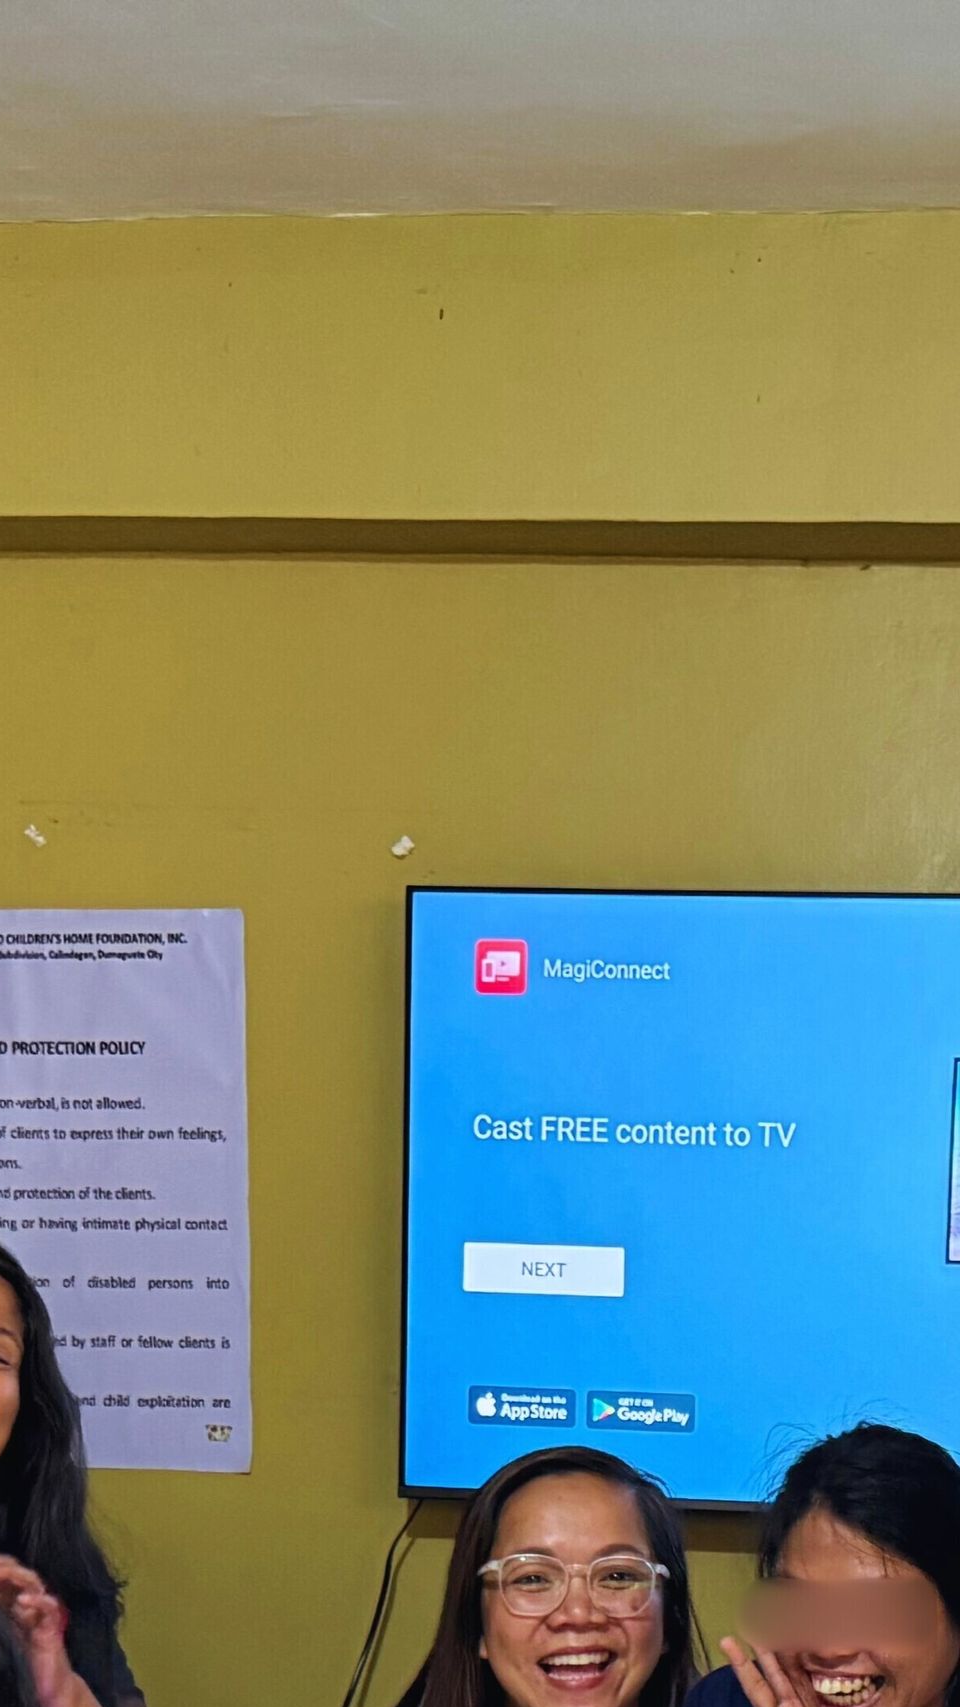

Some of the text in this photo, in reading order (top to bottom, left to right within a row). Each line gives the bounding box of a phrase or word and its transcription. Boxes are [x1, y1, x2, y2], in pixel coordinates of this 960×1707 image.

[6, 933, 62, 945] CHILDREN'S
[63, 933, 94, 944] HOME
[96, 932, 166, 946] FOUNDATION,
[167, 932, 188, 944] INC.
[146, 949, 162, 961] City
[543, 958, 671, 984] MagiConnect
[12, 1040, 96, 1055] PROTECTION
[100, 1040, 146, 1055] POLICY
[60, 1097, 70, 1110] is
[73, 1099, 93, 1110] not
[96, 1096, 146, 1110] allowed.
[10, 1126, 50, 1140] clients
[52, 1128, 66, 1140] to
[70, 1130, 114, 1142] express
[116, 1127, 144, 1140] their
[148, 1130, 174, 1140] own
[178, 1126, 227, 1142] feelings,
[472, 1114, 796, 1148] Cast FREE content to TV
[13, 1186, 75, 1201] protection
[78, 1186, 92, 1200] of
[94, 1186, 112, 1200] the
[114, 1186, 156, 1200] clients.
[21, 1218, 36, 1229] or
[39, 1217, 78, 1232] having
[82, 1217, 131, 1231] intimate
[134, 1217, 181, 1232] physical
[184, 1218, 228, 1231] contact
[520, 1260, 567, 1279] NEXT
[62, 1276, 76, 1288] of
[87, 1276, 136, 1289] disabled
[148, 1278, 194, 1291] persons
[206, 1276, 230, 1290] into
[72, 1336, 86, 1350] by
[90, 1336, 116, 1348] staff
[121, 1338, 133, 1348] or
[138, 1336, 174, 1348] fellow
[178, 1336, 216, 1349] clients
[221, 1336, 230, 1350] is
[103, 1394, 130, 1408] child
[137, 1395, 205, 1410] exploitation
[212, 1398, 231, 1409] are
[500, 1402, 568, 1421] App Store
[616, 1406, 690, 1427] Google Play
